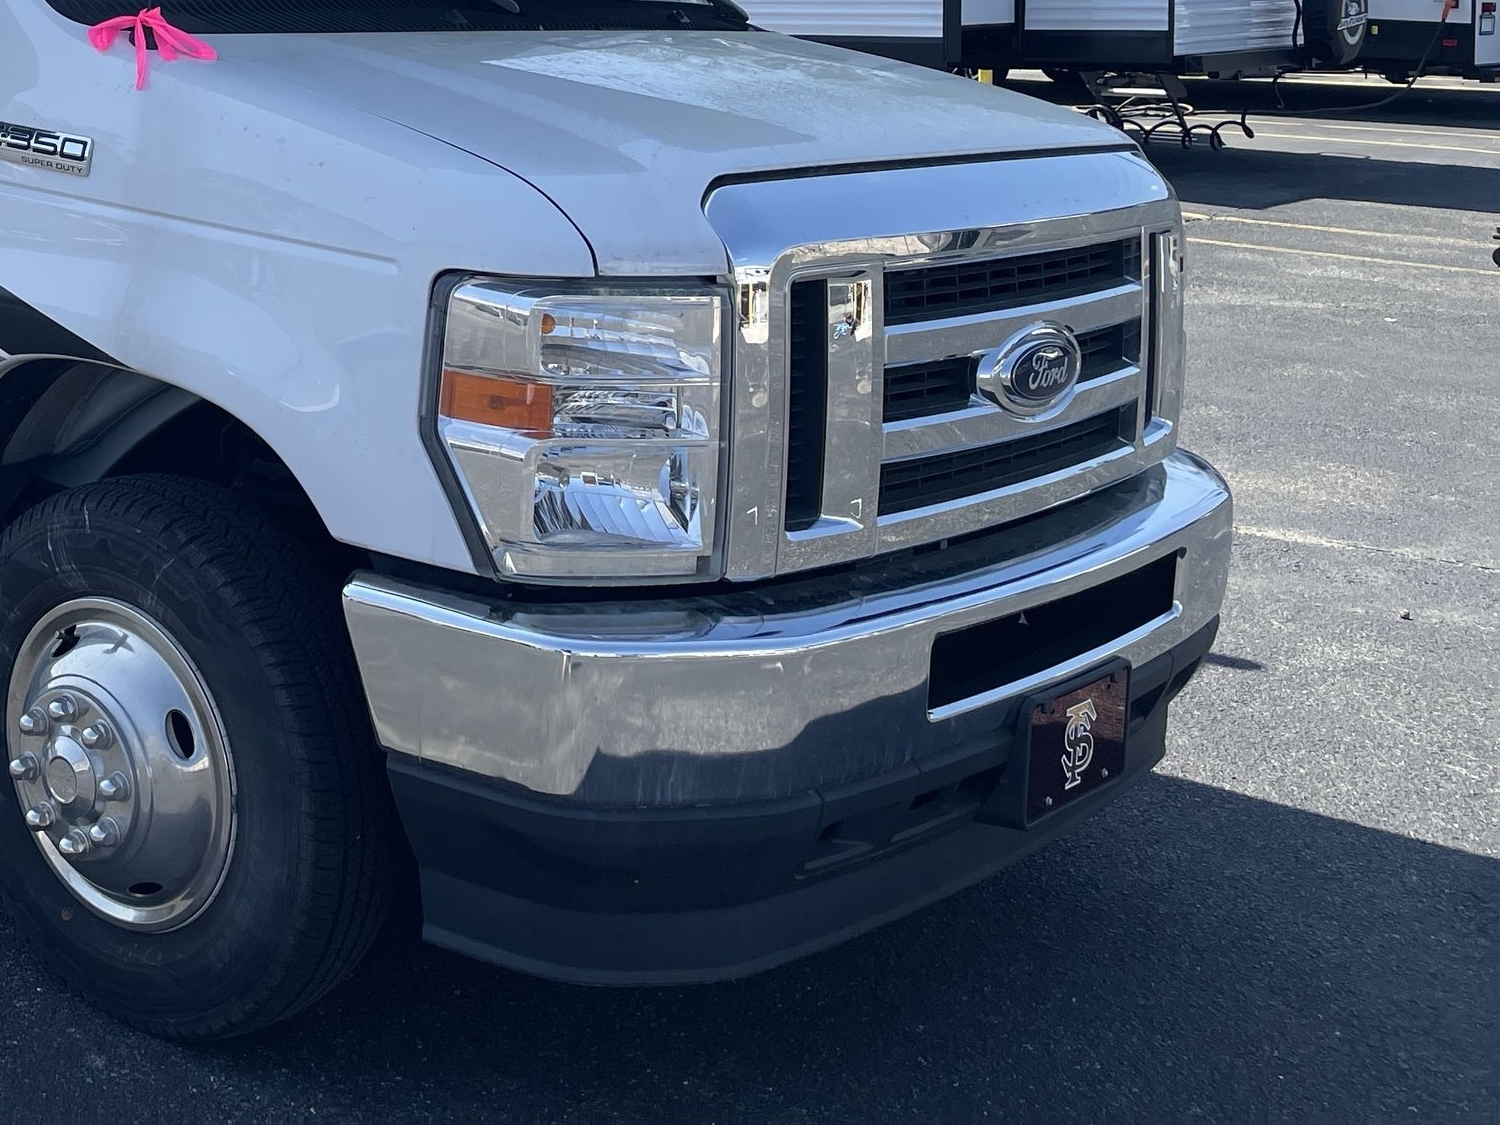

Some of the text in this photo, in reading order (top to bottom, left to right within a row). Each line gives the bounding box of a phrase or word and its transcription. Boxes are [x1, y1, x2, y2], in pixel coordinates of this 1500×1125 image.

[21, 155, 83, 174] SUPER DUTY
[1029, 347, 1068, 390] Ford
